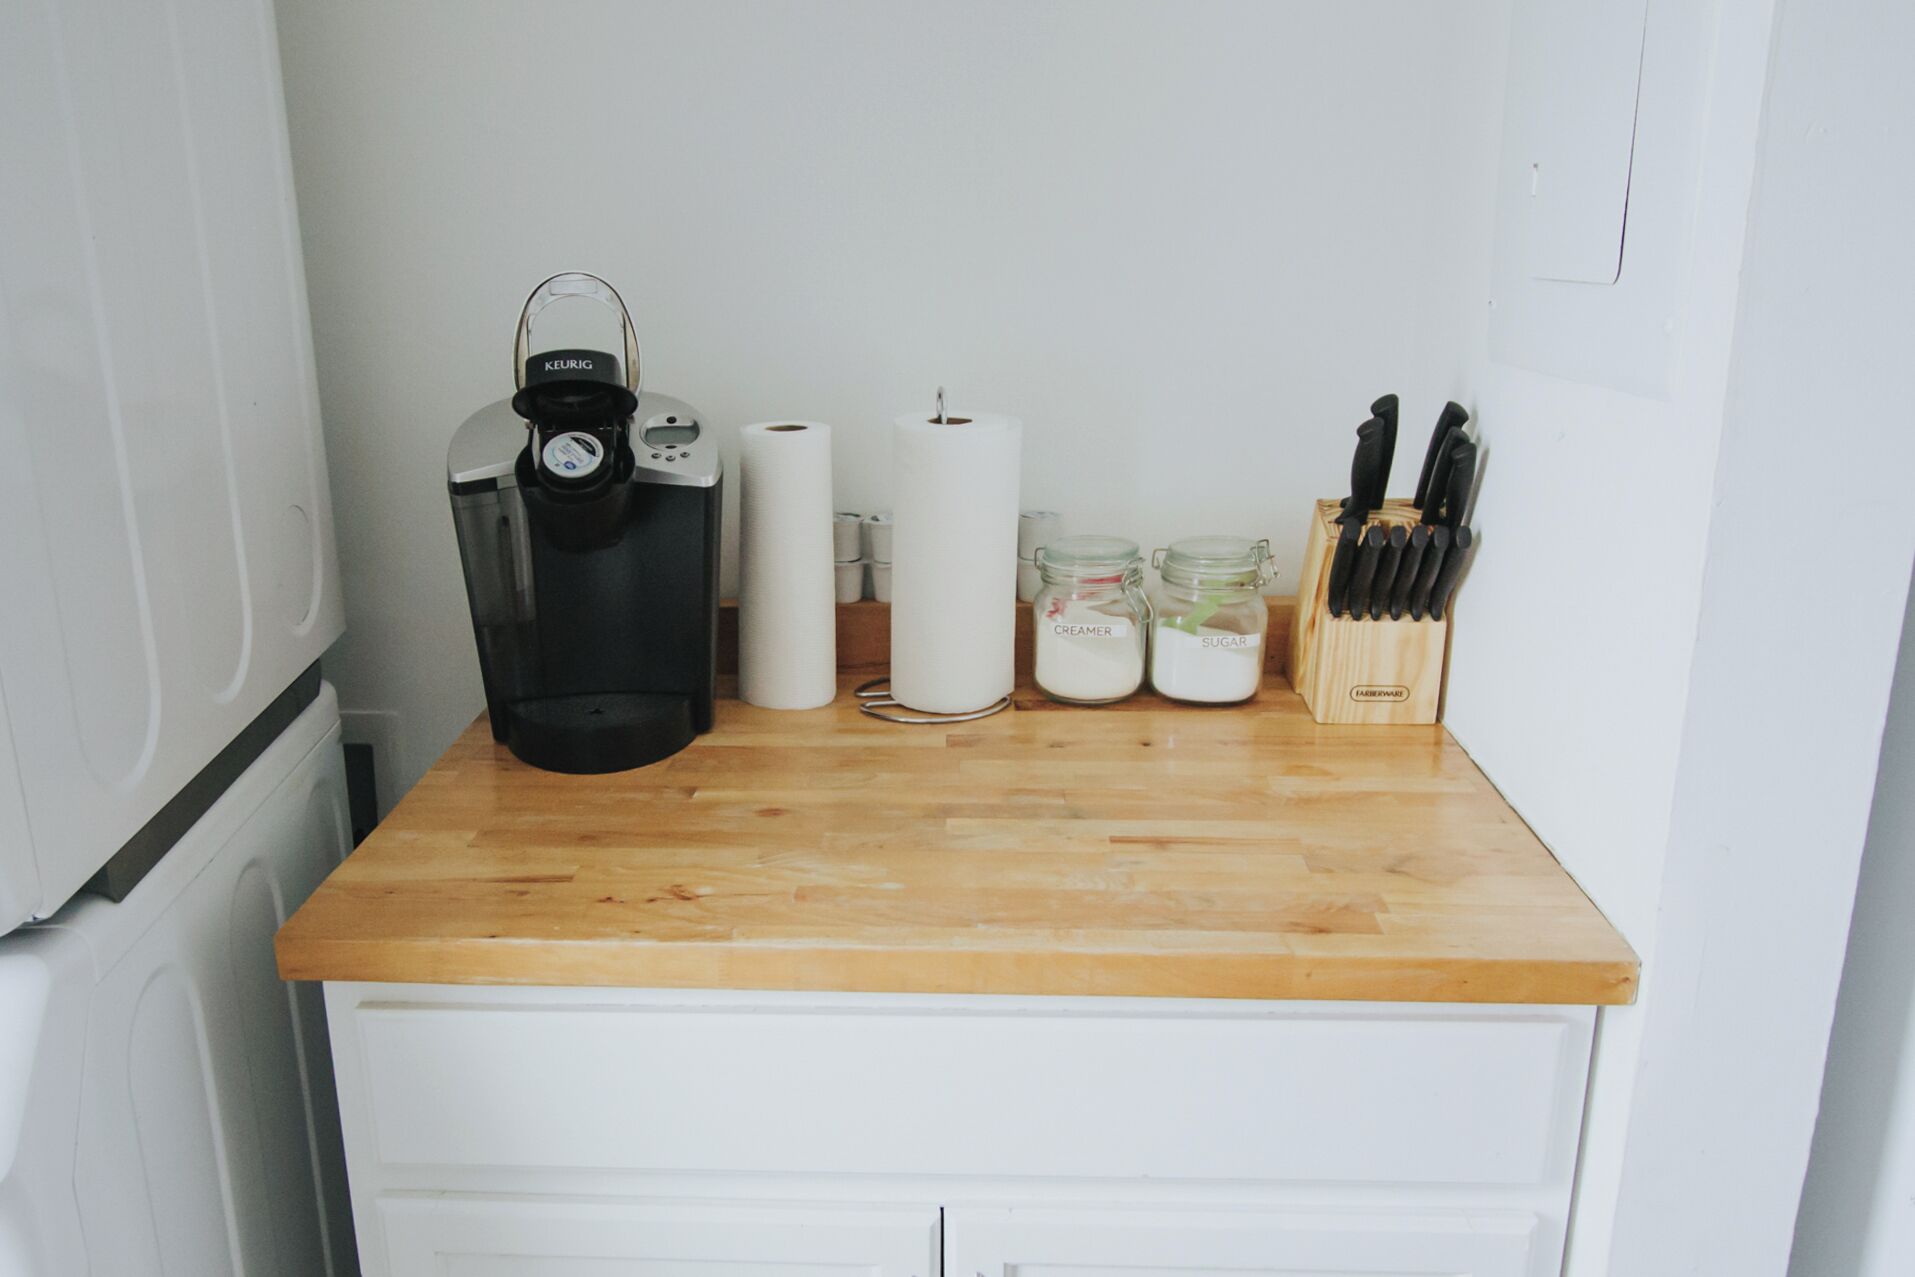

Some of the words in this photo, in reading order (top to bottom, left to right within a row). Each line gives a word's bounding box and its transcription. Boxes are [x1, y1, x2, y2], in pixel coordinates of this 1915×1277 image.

[545, 359, 593, 371] KEURIG
[1054, 624, 1112, 636] CREAMER
[1202, 636, 1248, 648] SUGAR
[1355, 689, 1403, 698] FARBERWARE
